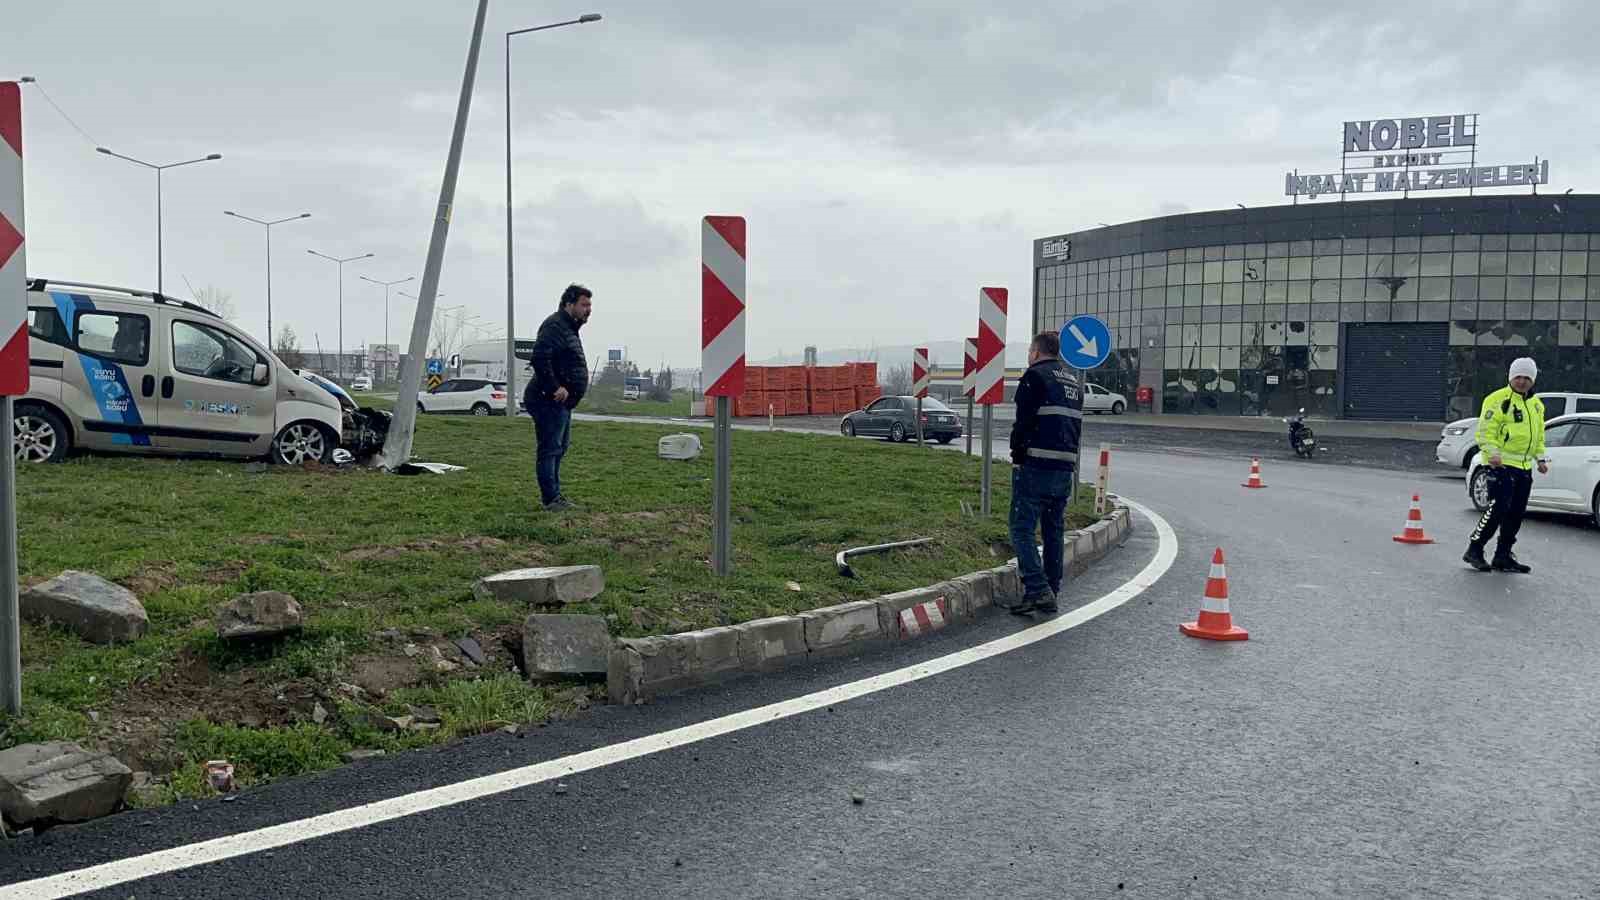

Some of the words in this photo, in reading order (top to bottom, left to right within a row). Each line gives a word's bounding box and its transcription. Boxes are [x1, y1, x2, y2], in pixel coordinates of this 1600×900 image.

[1344, 114, 1476, 151] NOBEL
[1373, 152, 1442, 167] EXPORT
[1285, 172, 1369, 198] İNŞAAT
[1374, 160, 1549, 192] MALZEMELERİ
